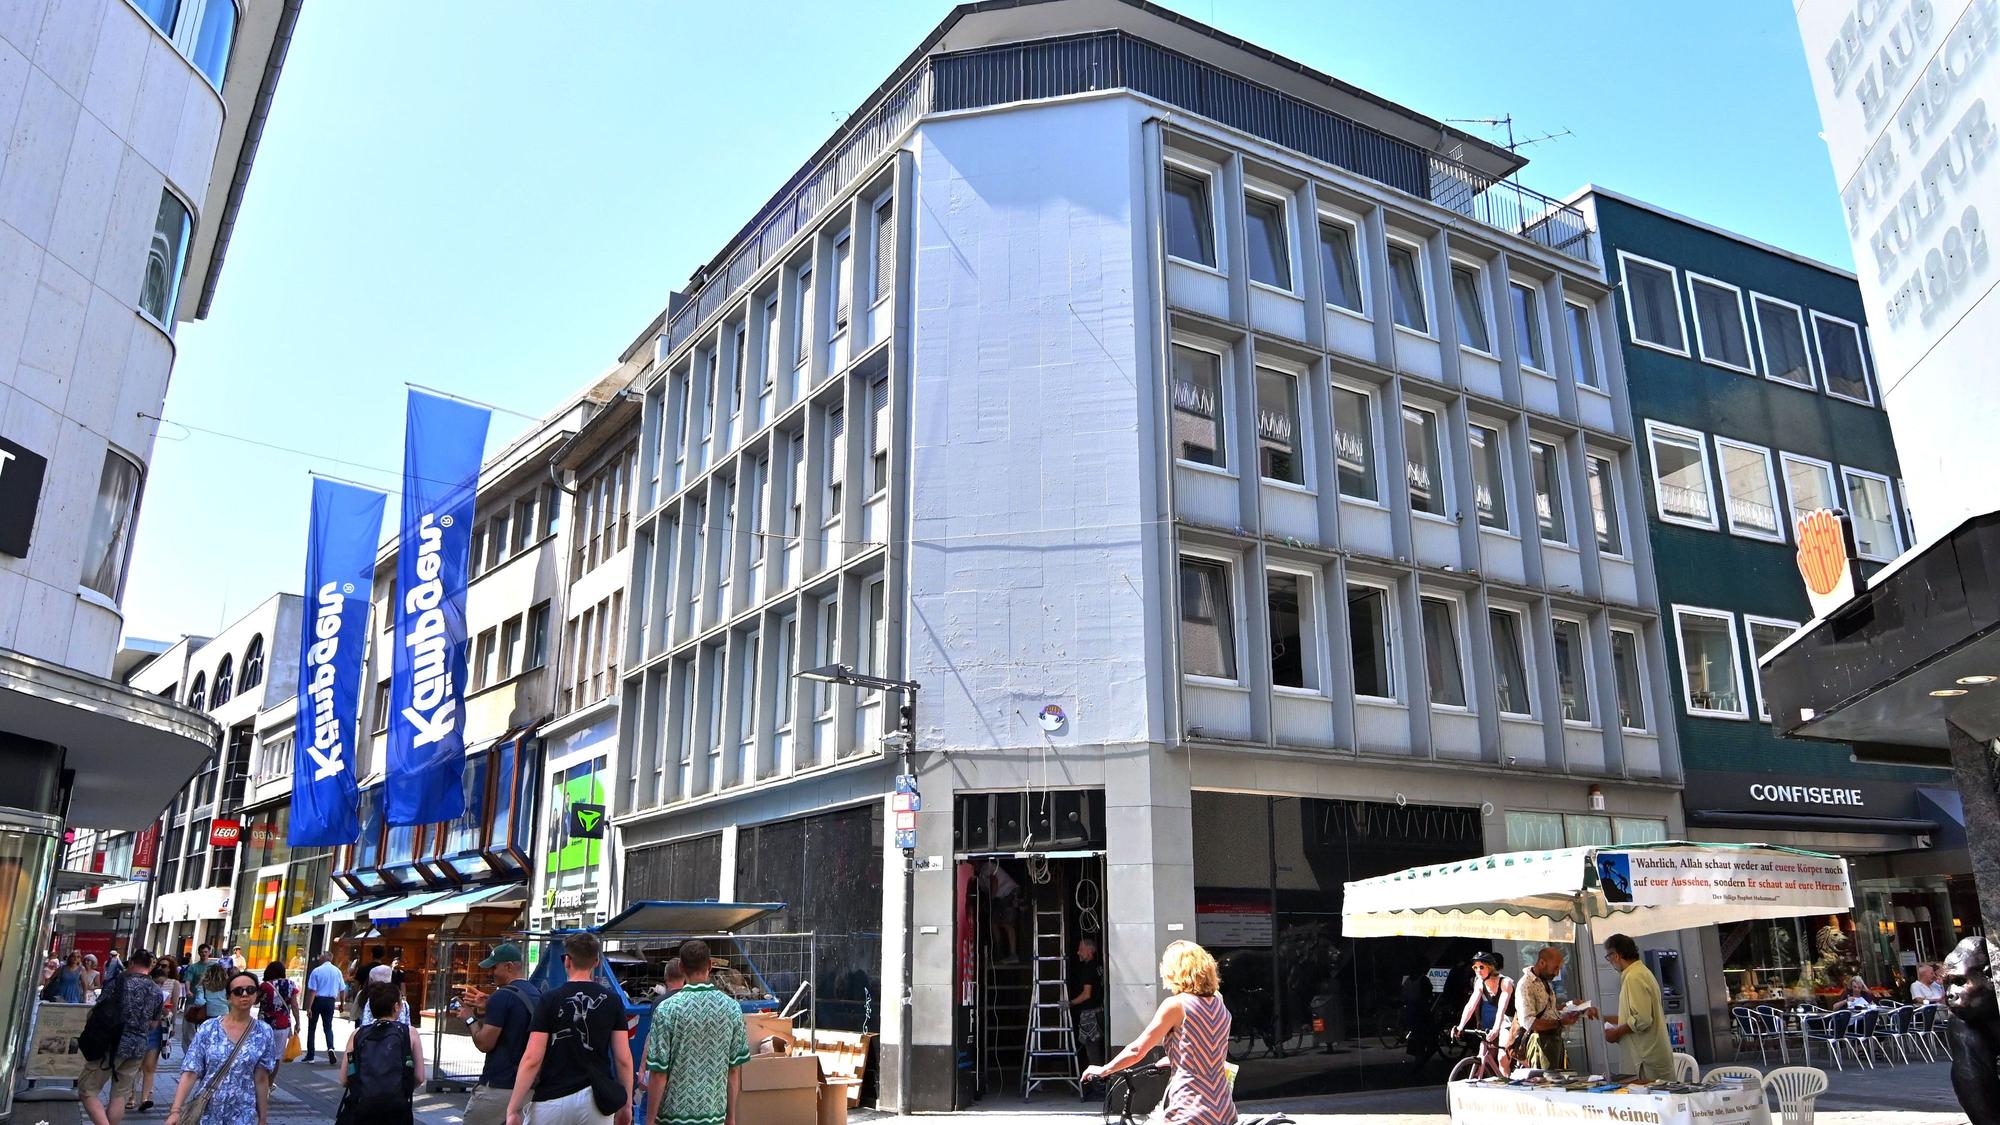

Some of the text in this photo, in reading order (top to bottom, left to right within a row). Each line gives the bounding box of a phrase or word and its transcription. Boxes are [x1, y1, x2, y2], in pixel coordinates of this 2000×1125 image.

[1911, 205, 1989, 324] 1882
[1749, 784, 1864, 806] CONFISERIE
[213, 827, 239, 838] LEGO
[1680, 858, 1703, 868] Allah
[1704, 860, 1731, 870] schaut
[1734, 861, 1758, 870] weder
[1760, 862, 1774, 871] auf
[1774, 864, 1795, 873] euere
[1797, 863, 1823, 875] Körper
[1824, 865, 1843, 874] noch
[1633, 876, 1648, 887] auf
[1650, 879, 1668, 887] euer
[1671, 876, 1711, 888] Aussehen,
[1714, 878, 1746, 888] sondern
[1748, 878, 1756, 887] Er
[1758, 879, 1783, 889] schaut
[1784, 880, 1796, 889] auf
[1798, 882, 1814, 891] eure
[1607, 1106, 1660, 1124] Keinen
